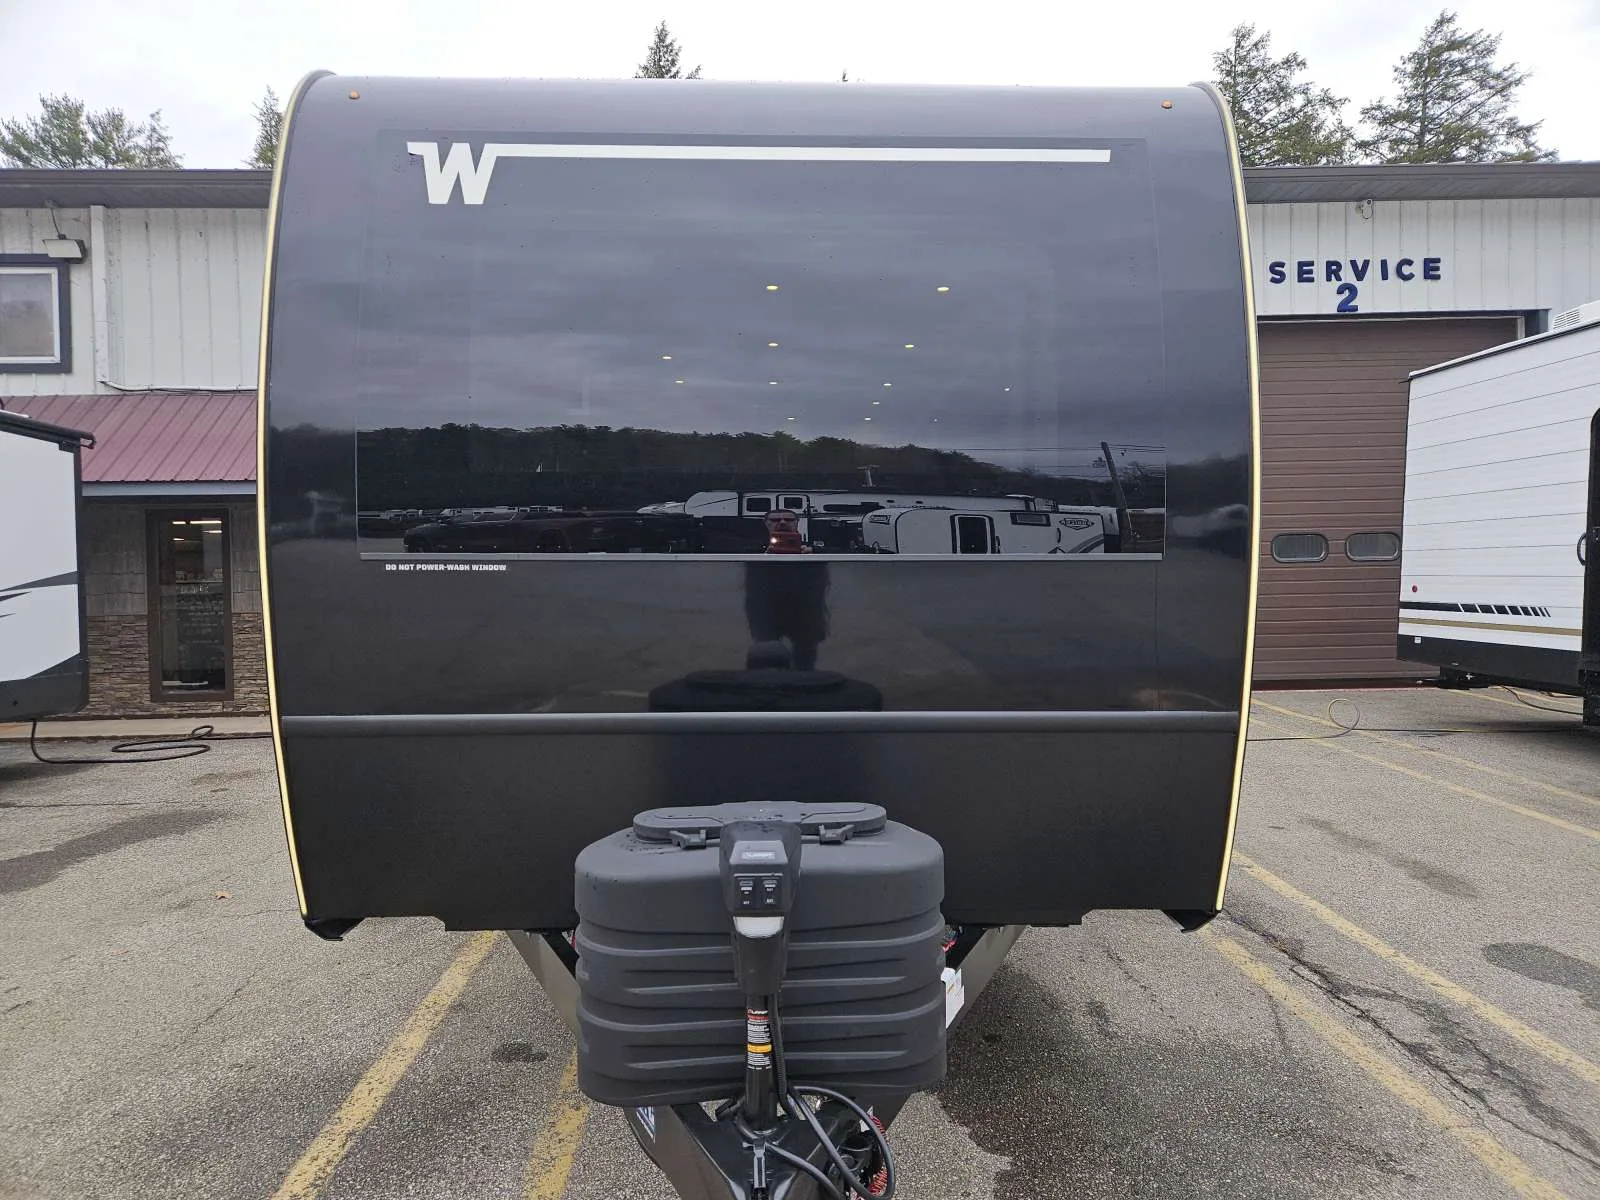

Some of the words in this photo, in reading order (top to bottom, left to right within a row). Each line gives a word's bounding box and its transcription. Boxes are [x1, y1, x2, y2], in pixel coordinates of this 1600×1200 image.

[406, 141, 498, 205] W
[1268, 257, 1443, 284] SERVICE
[1336, 282, 1359, 313] 2
[385, 563, 397, 571] DO
[398, 563, 415, 571] NOT
[416, 563, 470, 571] POWER-WASH
[471, 563, 507, 571] WINDOW
